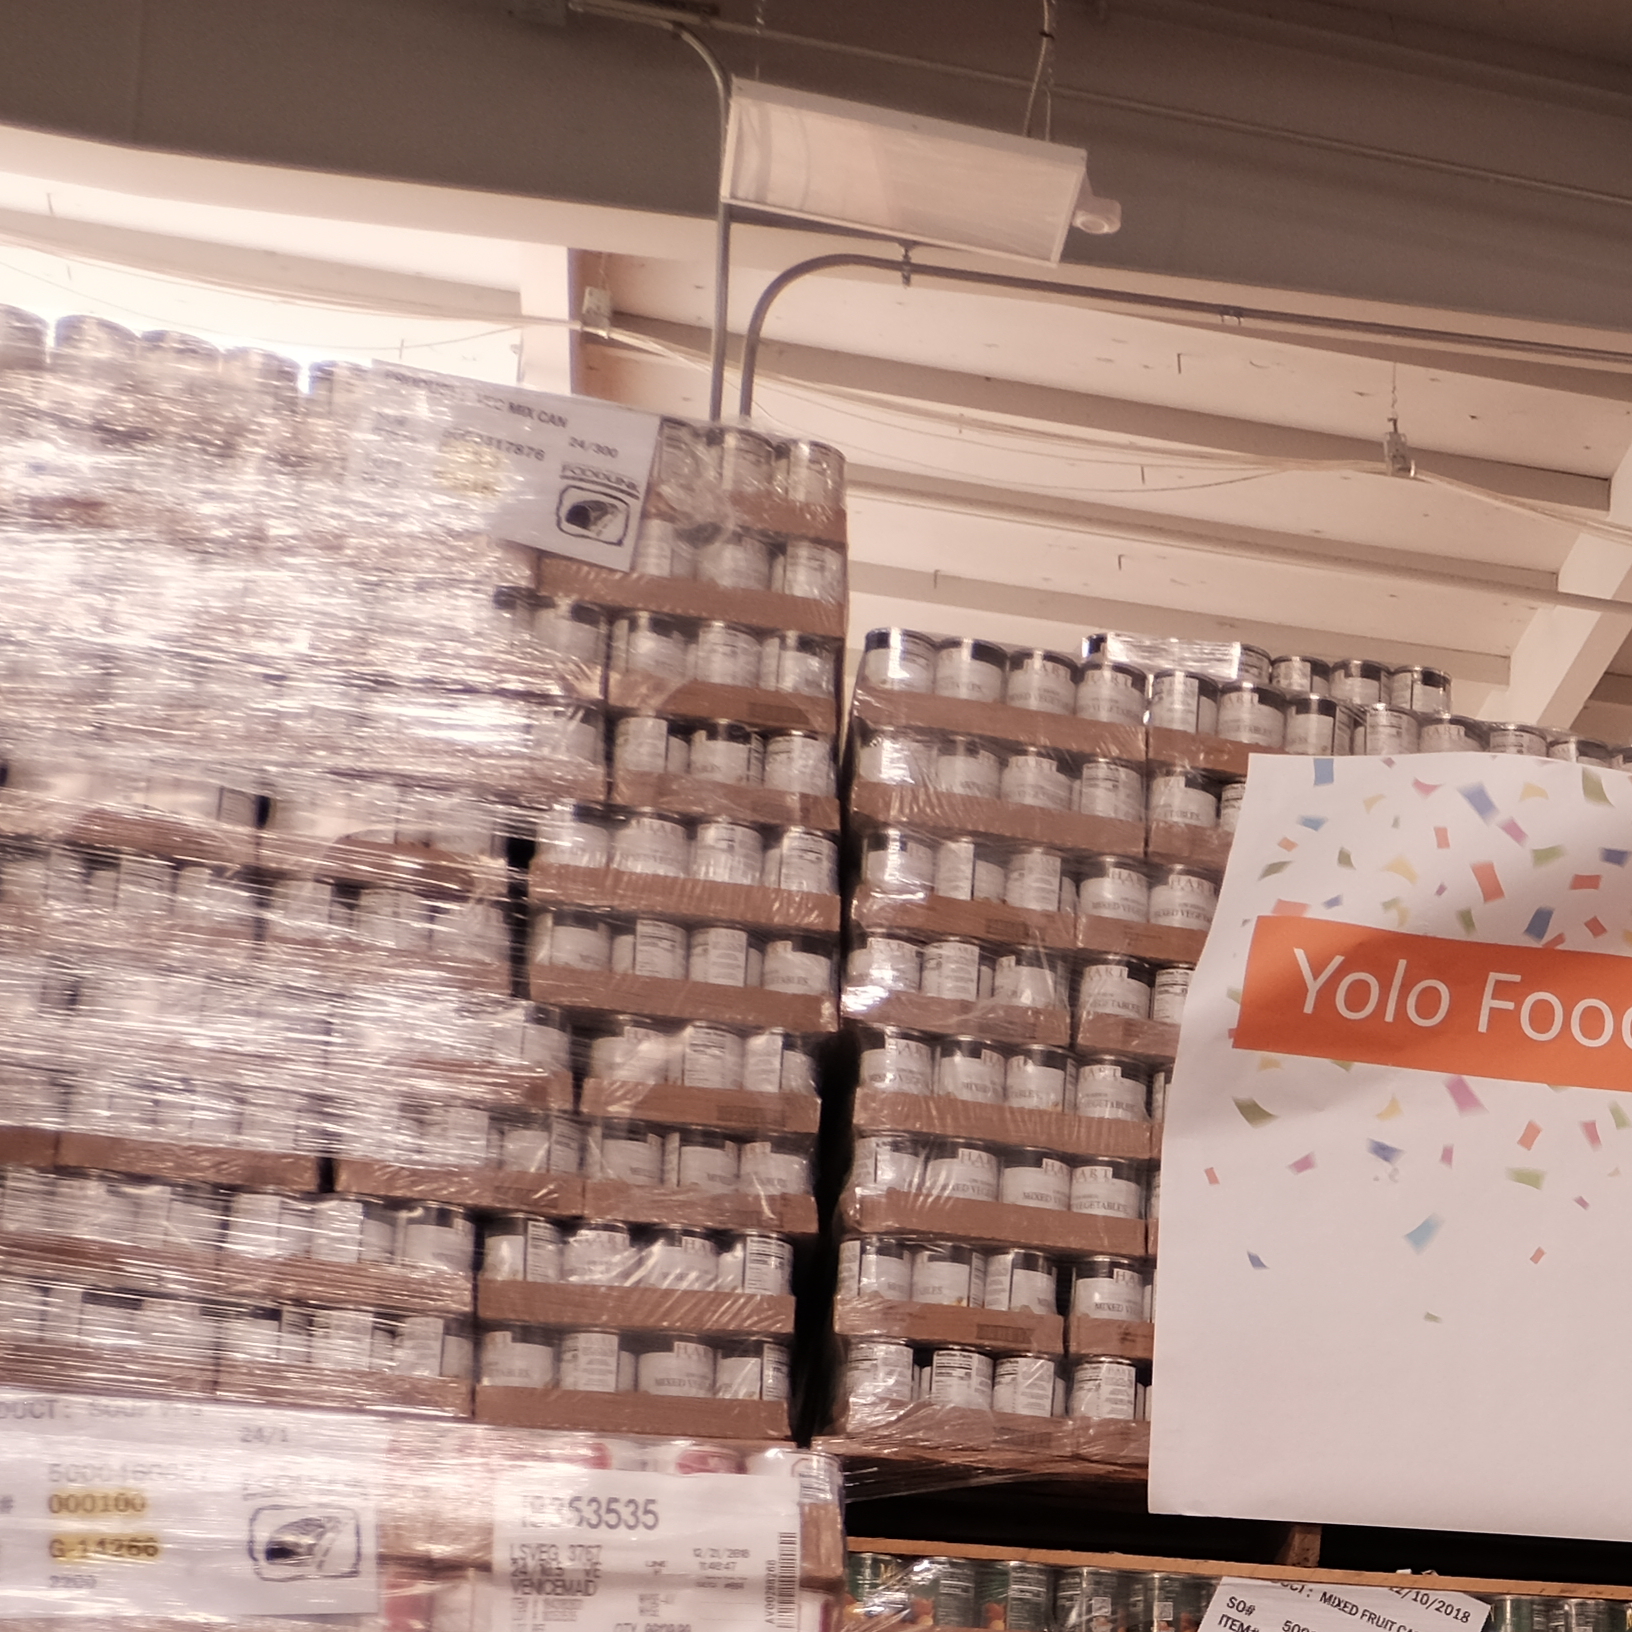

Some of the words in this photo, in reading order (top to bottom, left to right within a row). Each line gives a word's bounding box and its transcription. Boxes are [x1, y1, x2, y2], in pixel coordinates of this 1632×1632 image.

[1293, 948, 1450, 1027] Yolo
[1094, 1302, 1123, 1313] MIXED
[1227, 1596, 1255, 1616] SO#
[1319, 1591, 1359, 1617] MIXED
[1360, 1609, 1395, 1632] FRUIT
